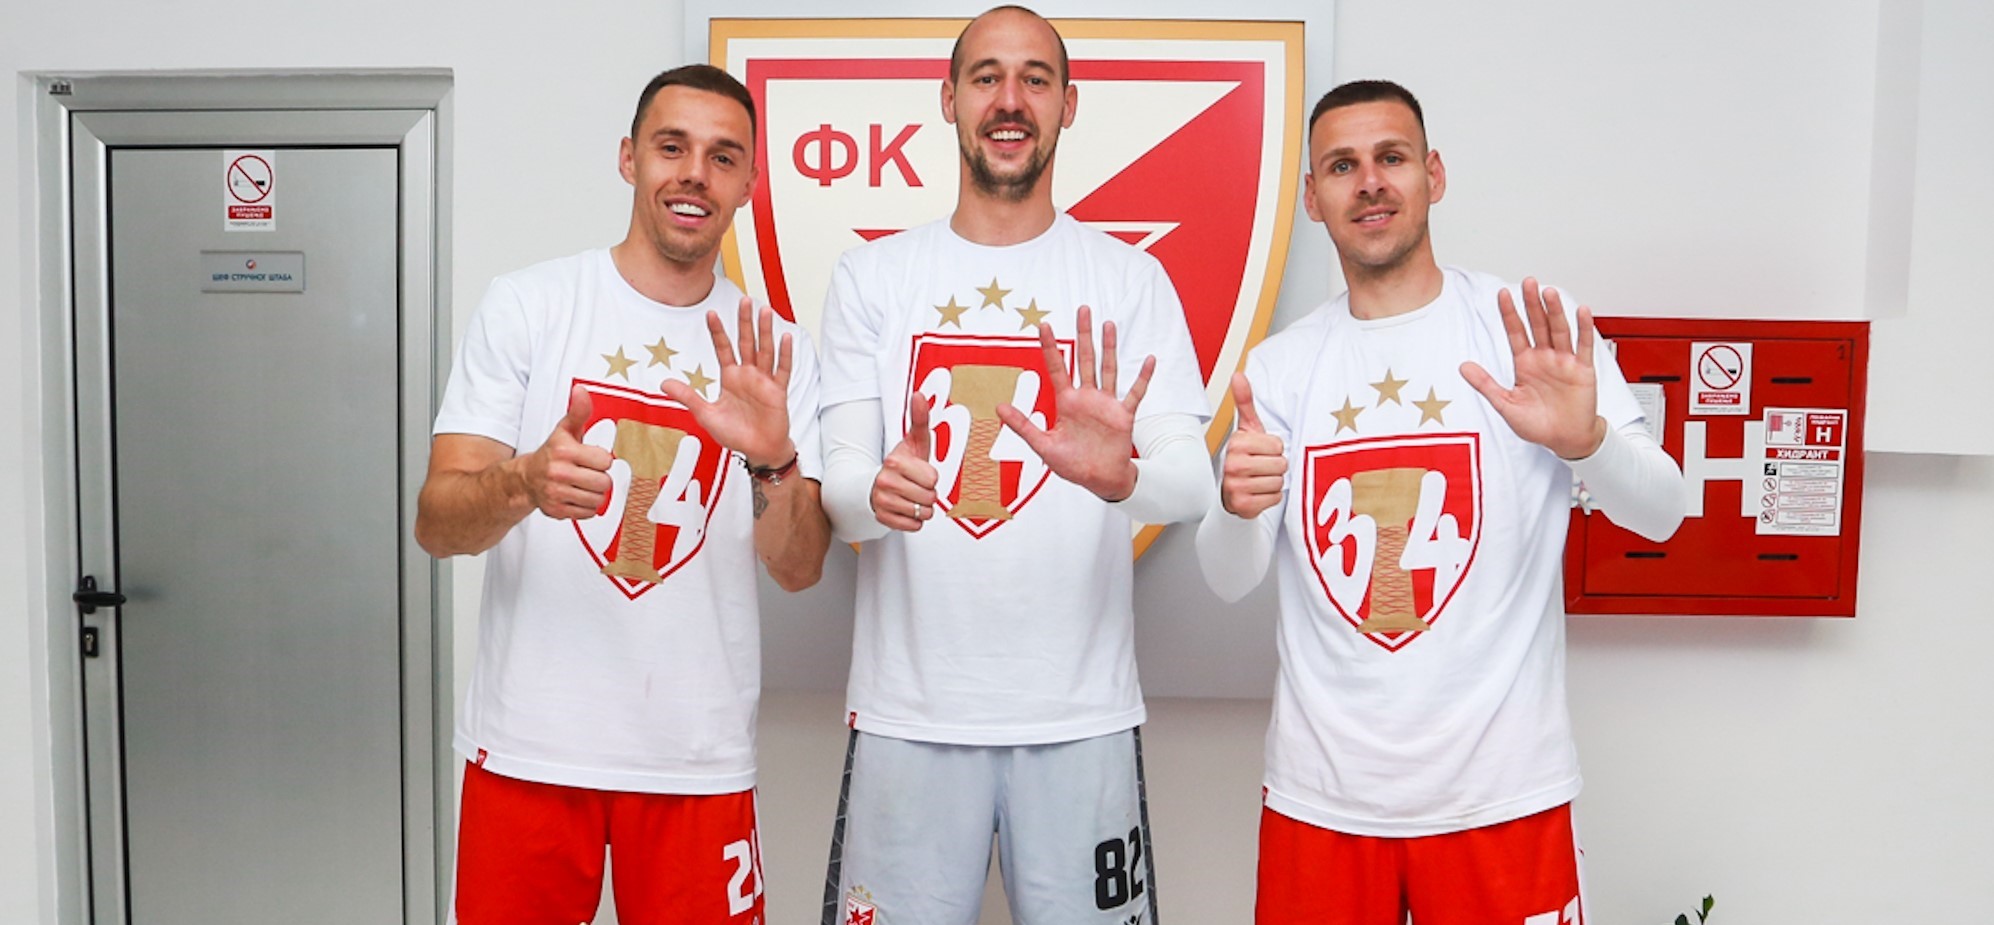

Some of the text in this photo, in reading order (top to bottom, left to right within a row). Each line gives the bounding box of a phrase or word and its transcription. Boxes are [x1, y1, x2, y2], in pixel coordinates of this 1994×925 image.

[792, 123, 924, 187] ФК
[1776, 447, 1829, 460] ХИДРАНТ
[1317, 470, 1471, 614] 34
[1095, 825, 1144, 911] 82
